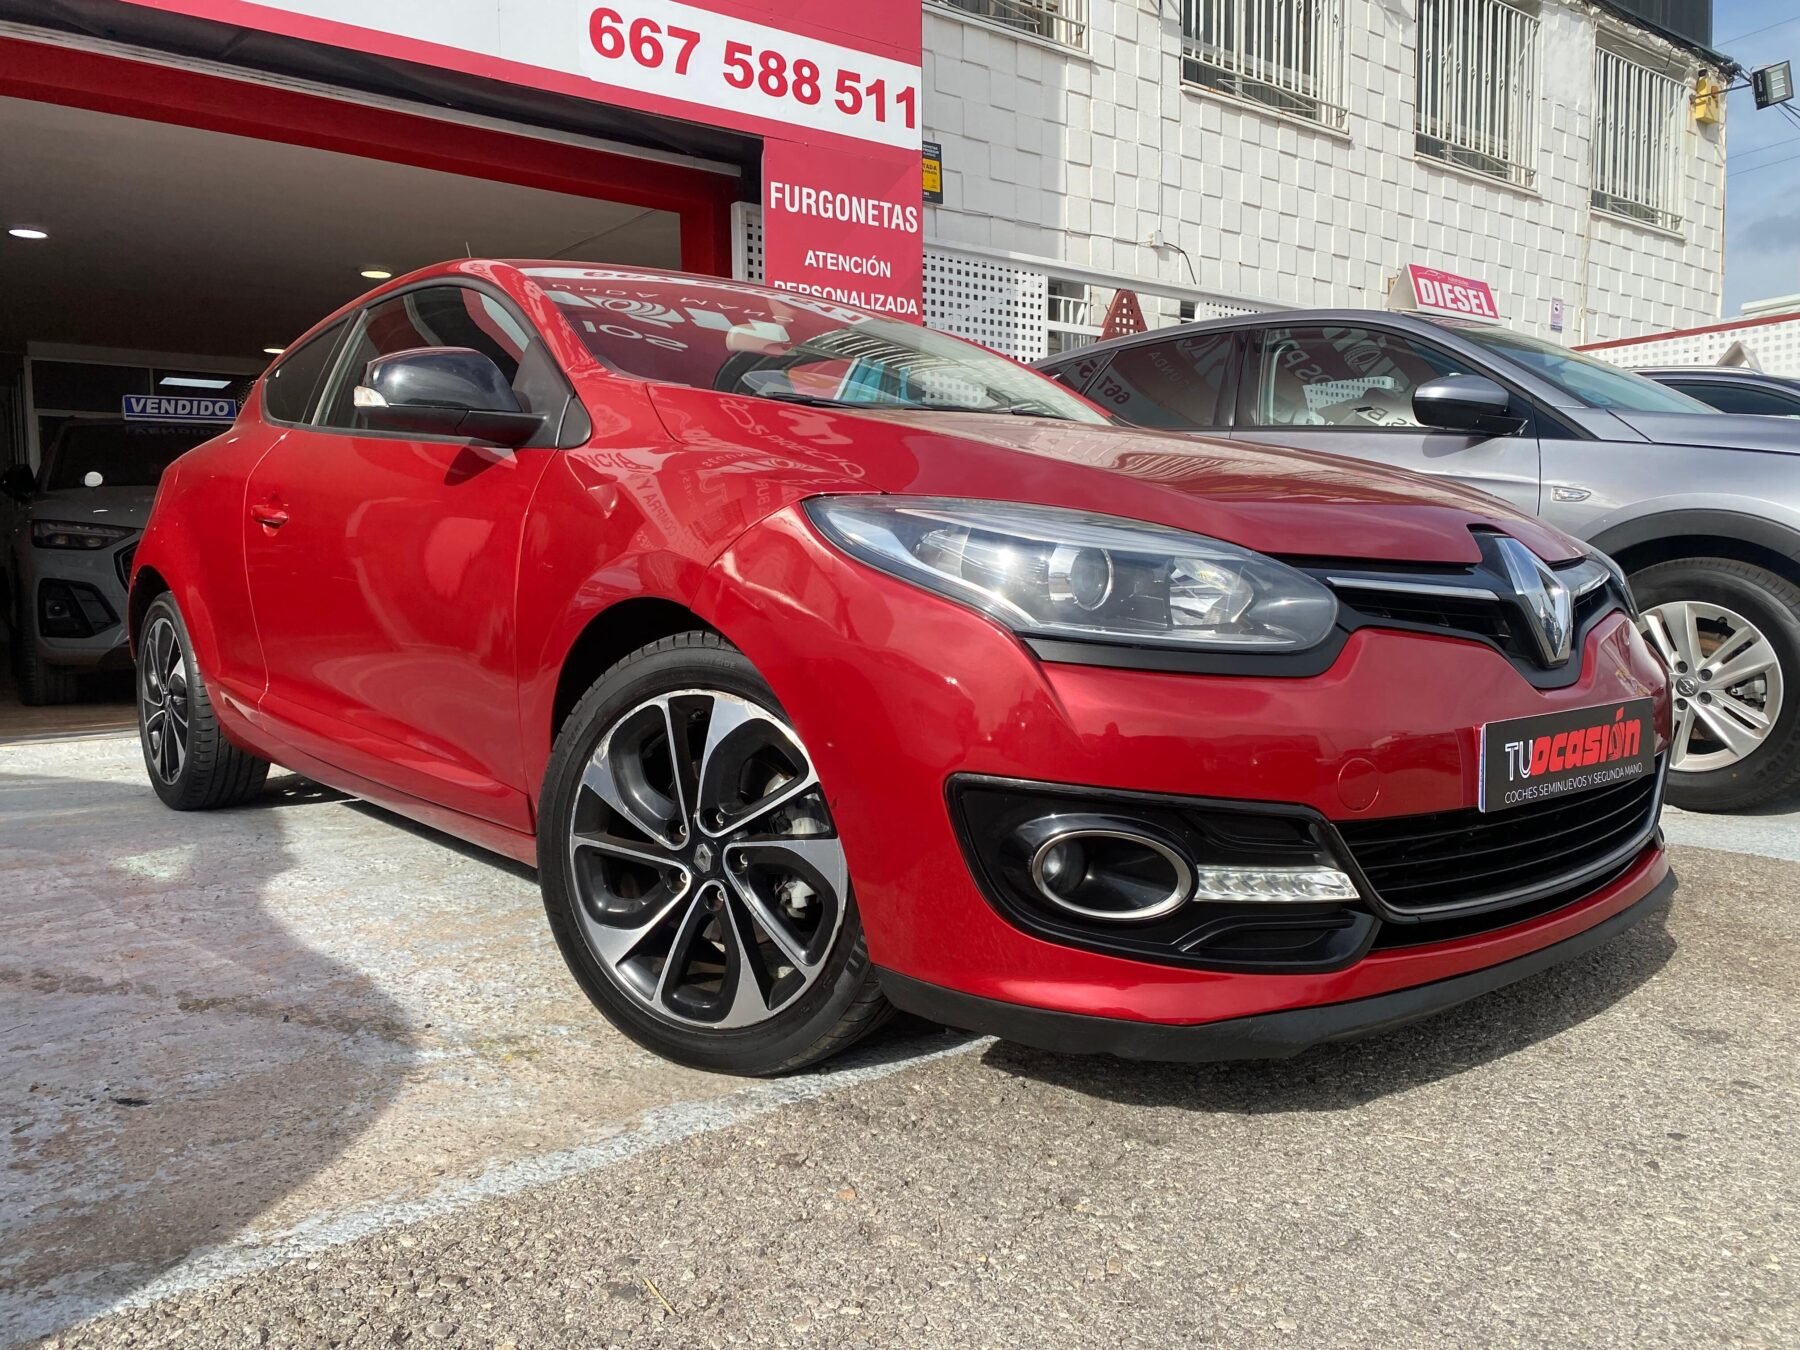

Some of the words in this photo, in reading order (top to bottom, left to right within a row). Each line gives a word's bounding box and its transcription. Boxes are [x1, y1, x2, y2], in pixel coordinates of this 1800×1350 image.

[589, 7, 700, 75] 667
[723, 40, 821, 105] 588
[834, 69, 915, 129] 511
[770, 181, 918, 233] FURGONETAS
[804, 249, 891, 278] ATENCIÓN
[1417, 278, 1495, 316] DIESEL
[130, 398, 229, 416] VENDIDO
[1504, 785, 1538, 804] COCHES
[1539, 775, 1587, 797] SEMINUEVOS
[1587, 774, 1593, 785] Y
[1593, 767, 1625, 784] SEGUNDA
[1624, 762, 1643, 776] MANO
